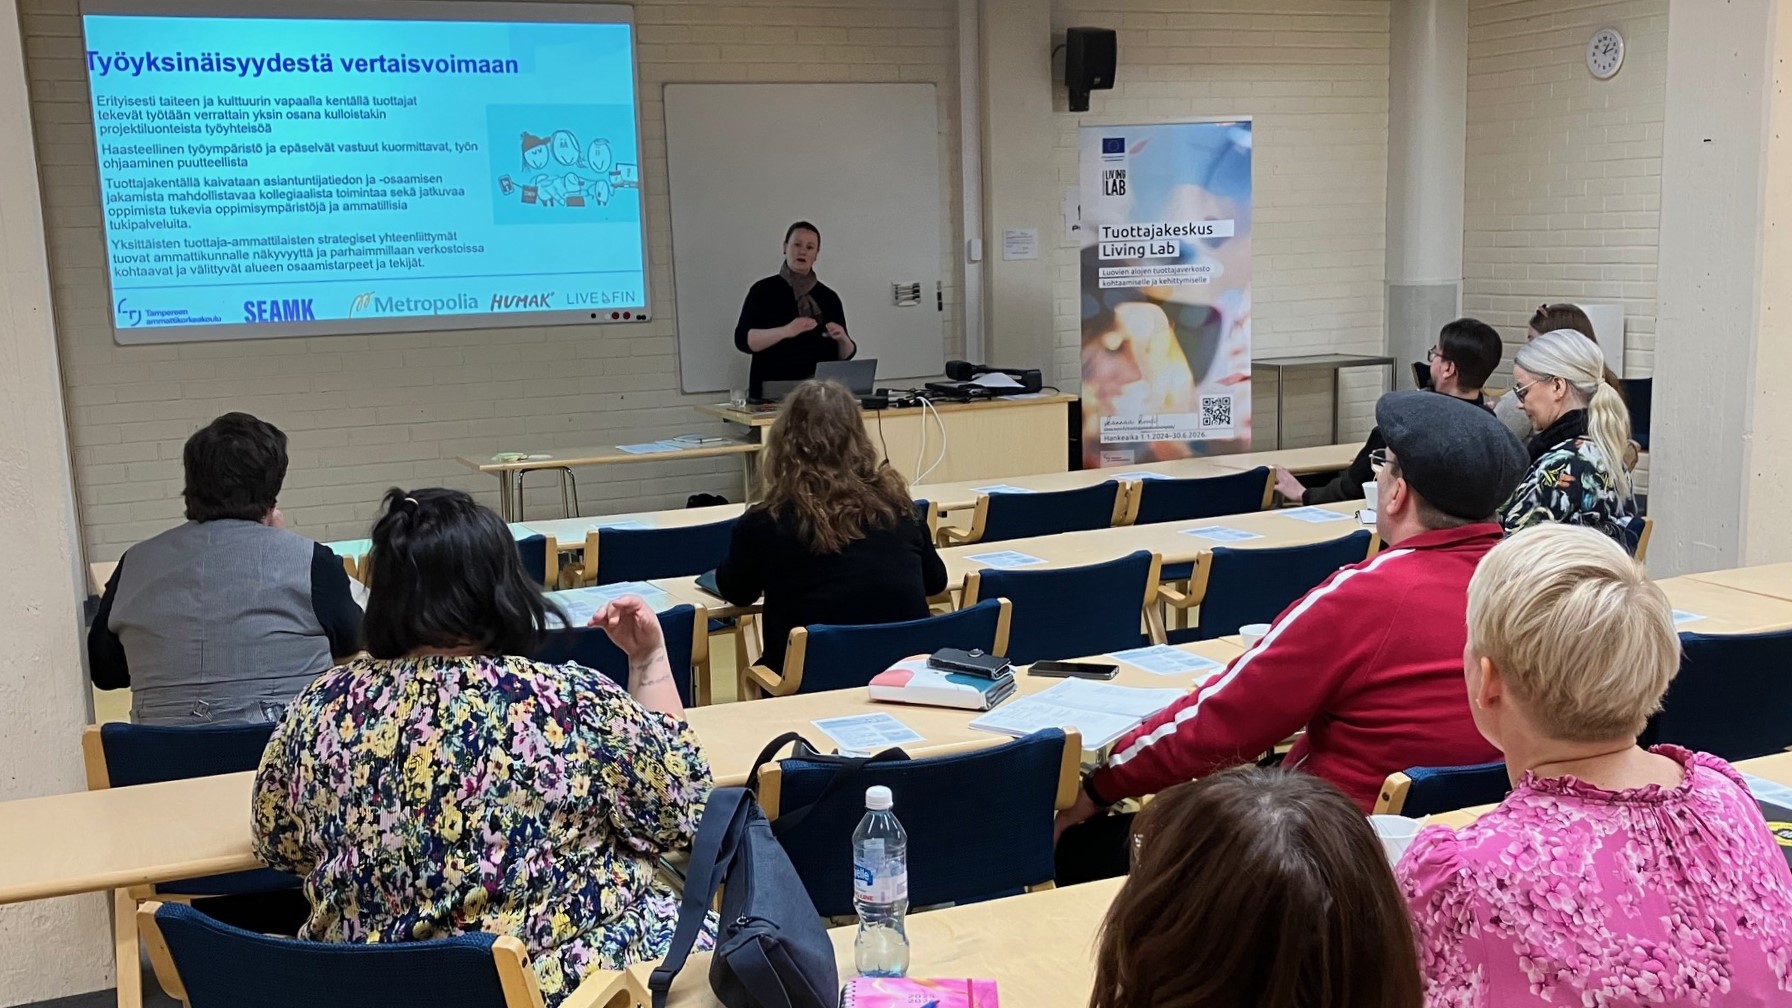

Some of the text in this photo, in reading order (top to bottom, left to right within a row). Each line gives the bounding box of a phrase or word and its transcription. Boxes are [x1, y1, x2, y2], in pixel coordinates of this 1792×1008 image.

[87, 51, 518, 77] Työyksinäisyydestä vertaisvoimaan
[97, 95, 417, 109] Erityisesti taiteen ja kulttuurin vapaalla kentällä tuottajat
[98, 109, 386, 123] tekevät työtään verrattain yksin osana kulloistakin
[100, 123, 272, 137] projektiluonteista työyhteisöä
[102, 144, 184, 155] Haasteellinen
[188, 144, 262, 156] työympäristö
[266, 144, 276, 156] ja
[280, 142, 335, 156] epäselvät
[338, 143, 379, 152] vastuut
[455, 142, 478, 154] työn
[103, 158, 248, 170] ohjaaminen puutteellista
[106, 174, 442, 191] Tuottajakentällä kaivataan asiantuntijatiedon ja -osaamisen
[1105, 170, 1126, 180] LIVING
[106, 186, 464, 205] jakamista mahdollistavaa kollegiaalista toimintaa sekä jatkuvaa
[1105, 179, 1126, 196] LAB
[108, 200, 408, 218] oppimista tukevia oppimisympäristöjä ja ammatillisia
[110, 219, 191, 232] tukipalveluita.
[1102, 224, 1213, 240] Tuottajakeskus
[112, 232, 457, 250] Yksittäisten tuottaja-ammattilaisten strategiset yhteenliittymät
[113, 244, 484, 264] tuovat ammattikunnalle näkyvyyttä ja parhaimmillaan verkostoissa
[1102, 242, 1175, 258] Living Lab
[115, 258, 424, 278] kohtaavat ja välittyvät alueen osaamistarpeet ja tekijät.
[1102, 266, 1210, 278] Luovien alojen tuottajaverkosto
[1102, 276, 1207, 287] kohtaamiselle ja kehittymiselle
[374, 294, 478, 315] Metropolia
[490, 292, 551, 311] HUMAK
[146, 308, 188, 318] Tampereen
[244, 299, 316, 323] SEAMK
